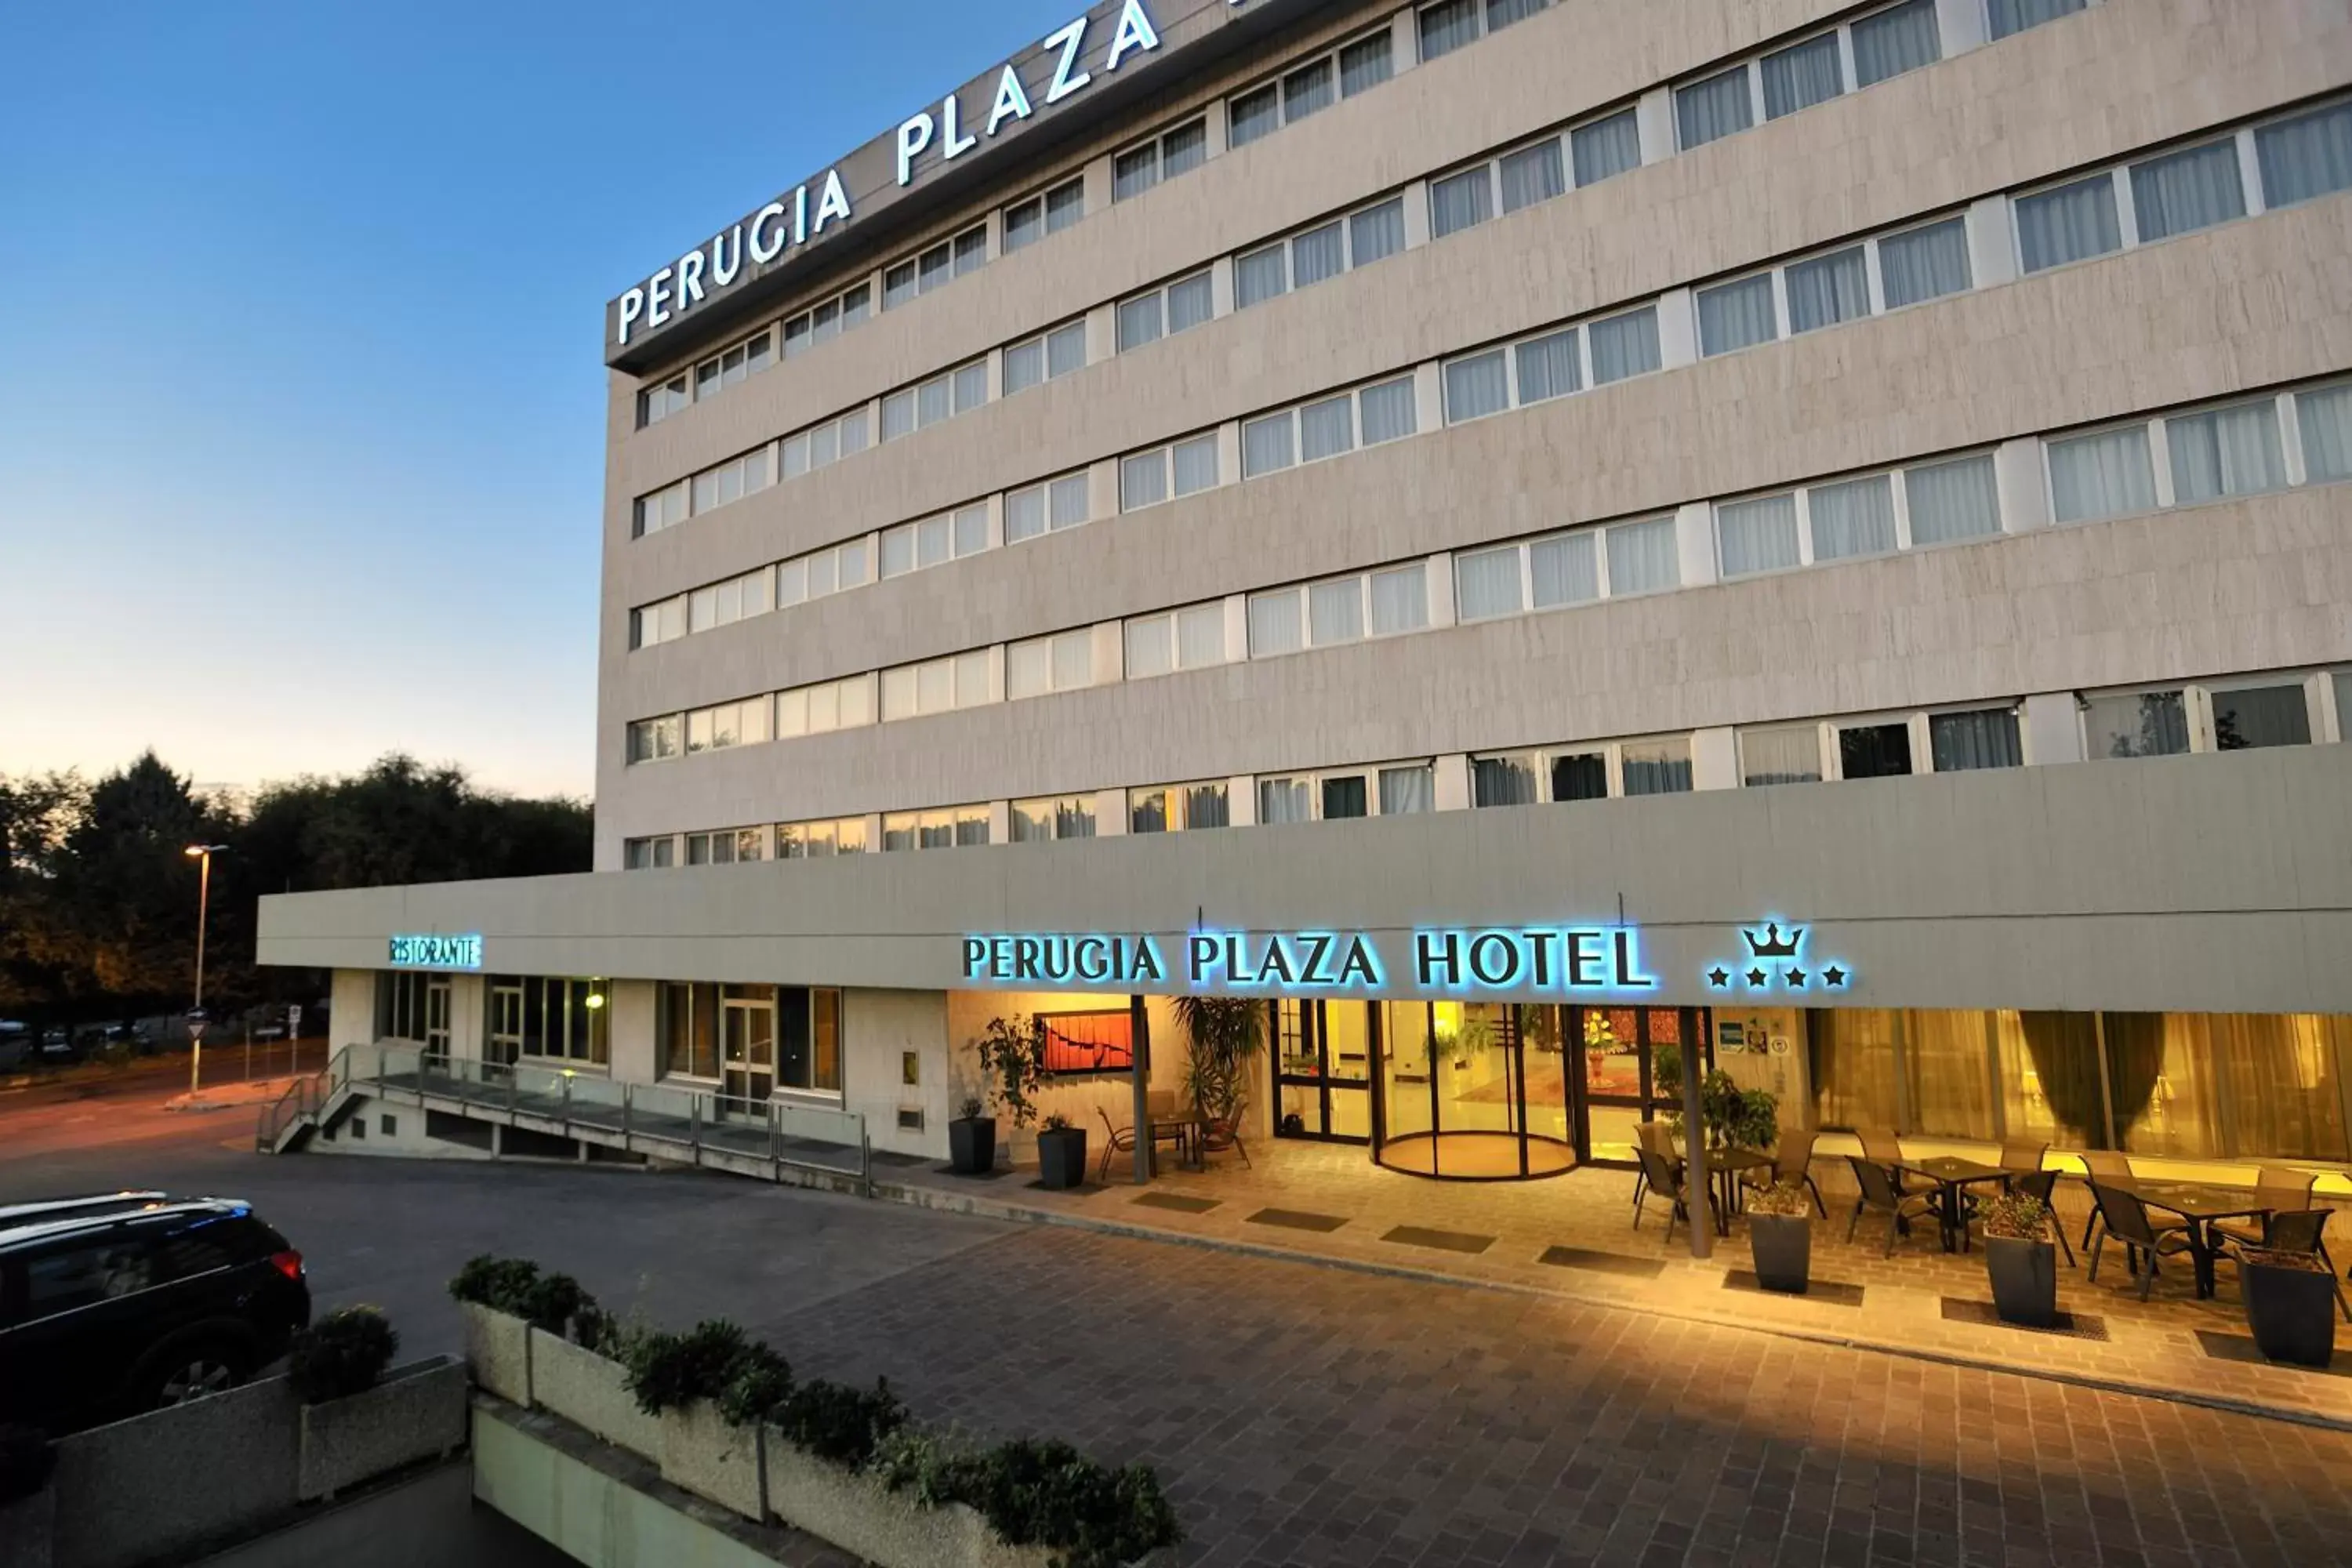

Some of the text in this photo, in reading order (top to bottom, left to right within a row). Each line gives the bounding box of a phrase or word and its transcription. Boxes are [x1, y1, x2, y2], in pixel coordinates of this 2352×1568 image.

[619, 0, 1159, 345] PERUGIA PLAZA
[390, 938, 481, 965] RISTORANTE
[964, 931, 1651, 985] PERUGIA PLAZA HOTEL
